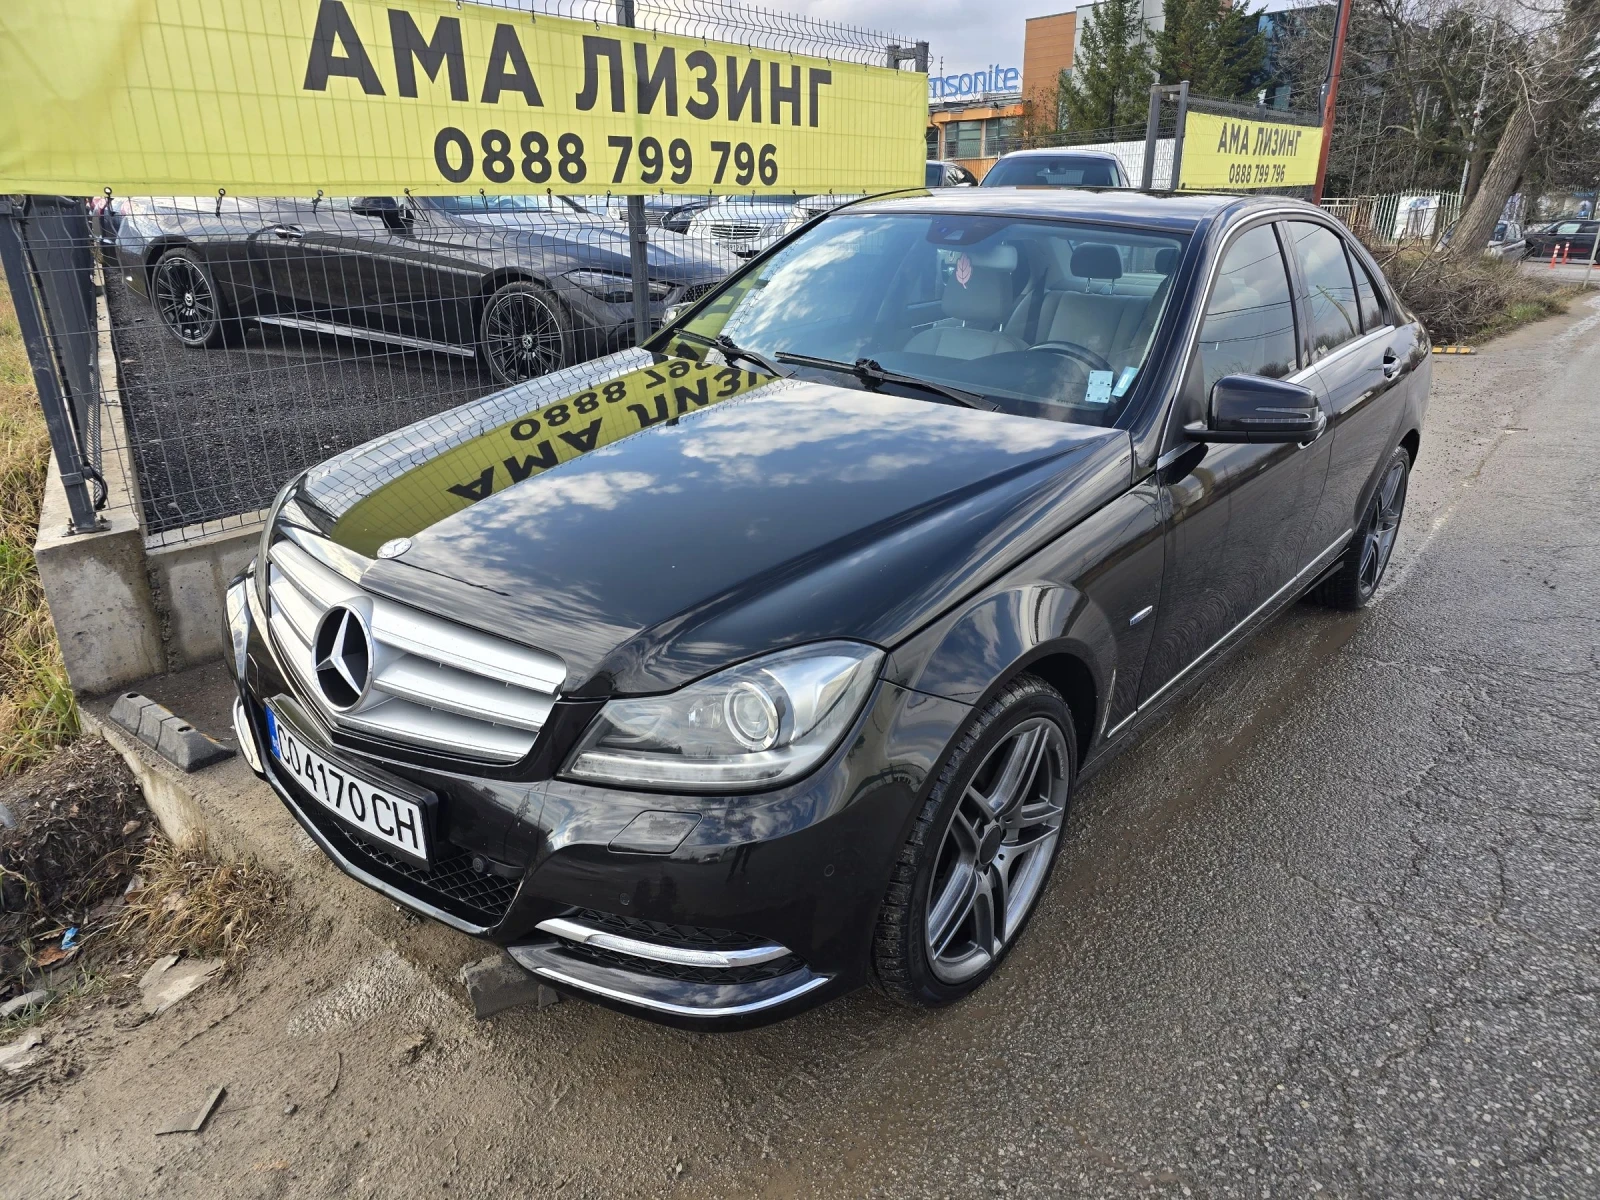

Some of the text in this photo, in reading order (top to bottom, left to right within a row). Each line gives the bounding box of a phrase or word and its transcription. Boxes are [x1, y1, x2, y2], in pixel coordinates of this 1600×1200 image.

[303, 0, 832, 128] АМА ЛИЗИНГ
[434, 126, 779, 186] 0888 799 796
[1217, 122, 1302, 157] АМА ЛИЗИНГ
[1229, 163, 1286, 184] 0888 799 796
